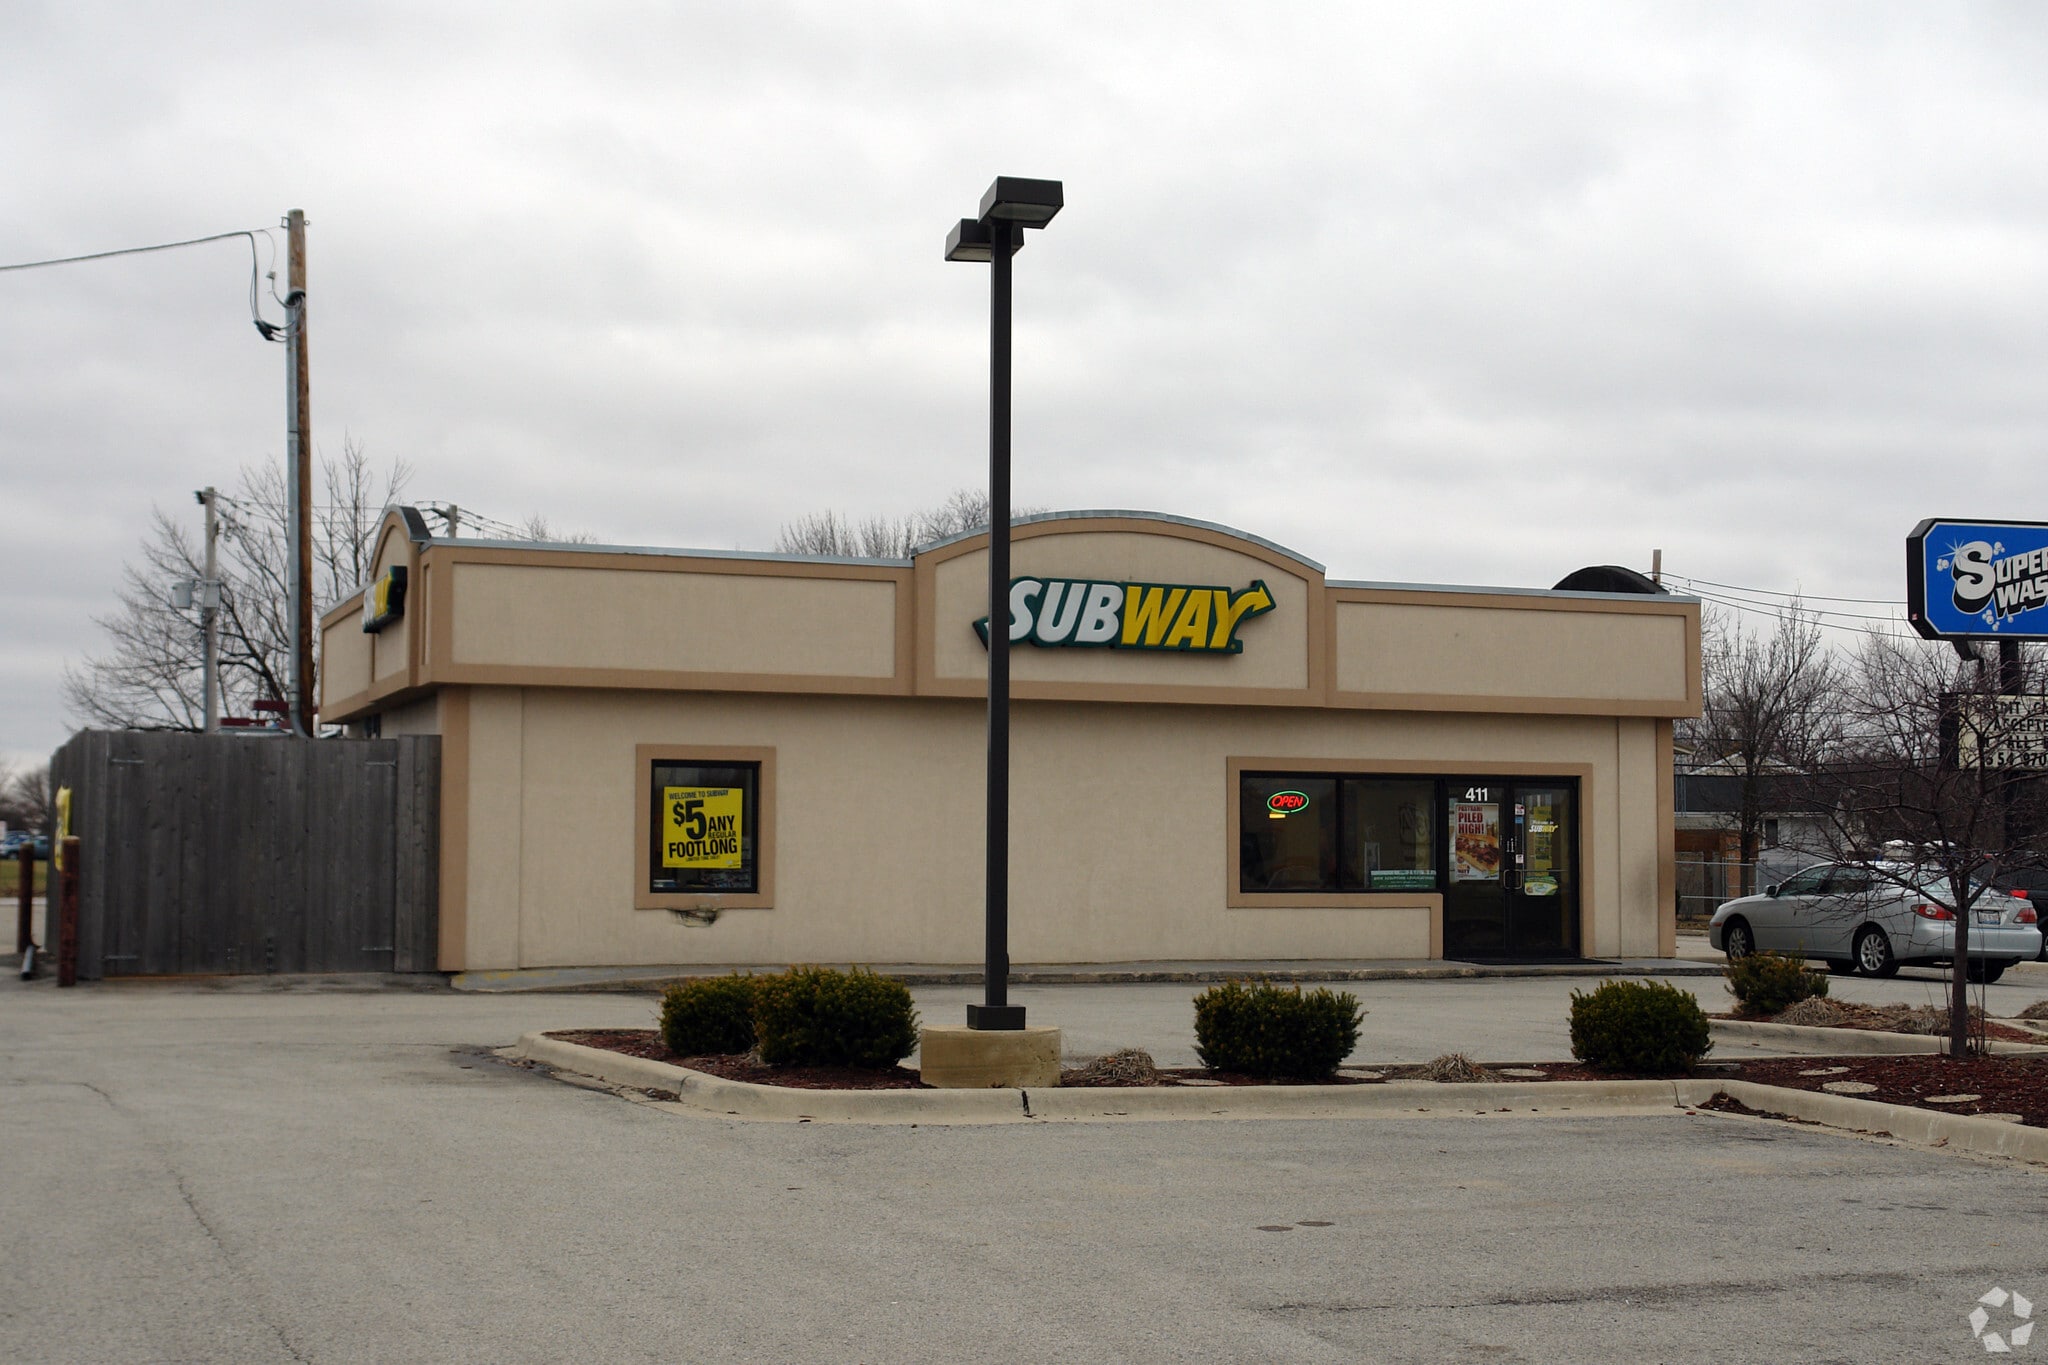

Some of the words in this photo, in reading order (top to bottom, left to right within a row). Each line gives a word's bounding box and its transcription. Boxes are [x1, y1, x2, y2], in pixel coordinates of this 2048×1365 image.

[988, 578, 1272, 649] SUBWAY
[668, 790, 697, 800] WELCOME
[698, 790, 705, 798] TO
[1271, 795, 1304, 808] OPEN
[1465, 787, 1489, 802] 411
[673, 800, 707, 840] $5
[708, 815, 735, 832] ANY
[1458, 812, 1483, 822] PILED
[708, 831, 736, 839] REGULAR
[1458, 824, 1484, 834] HIGH!
[668, 838, 738, 858] FOOTLONG
